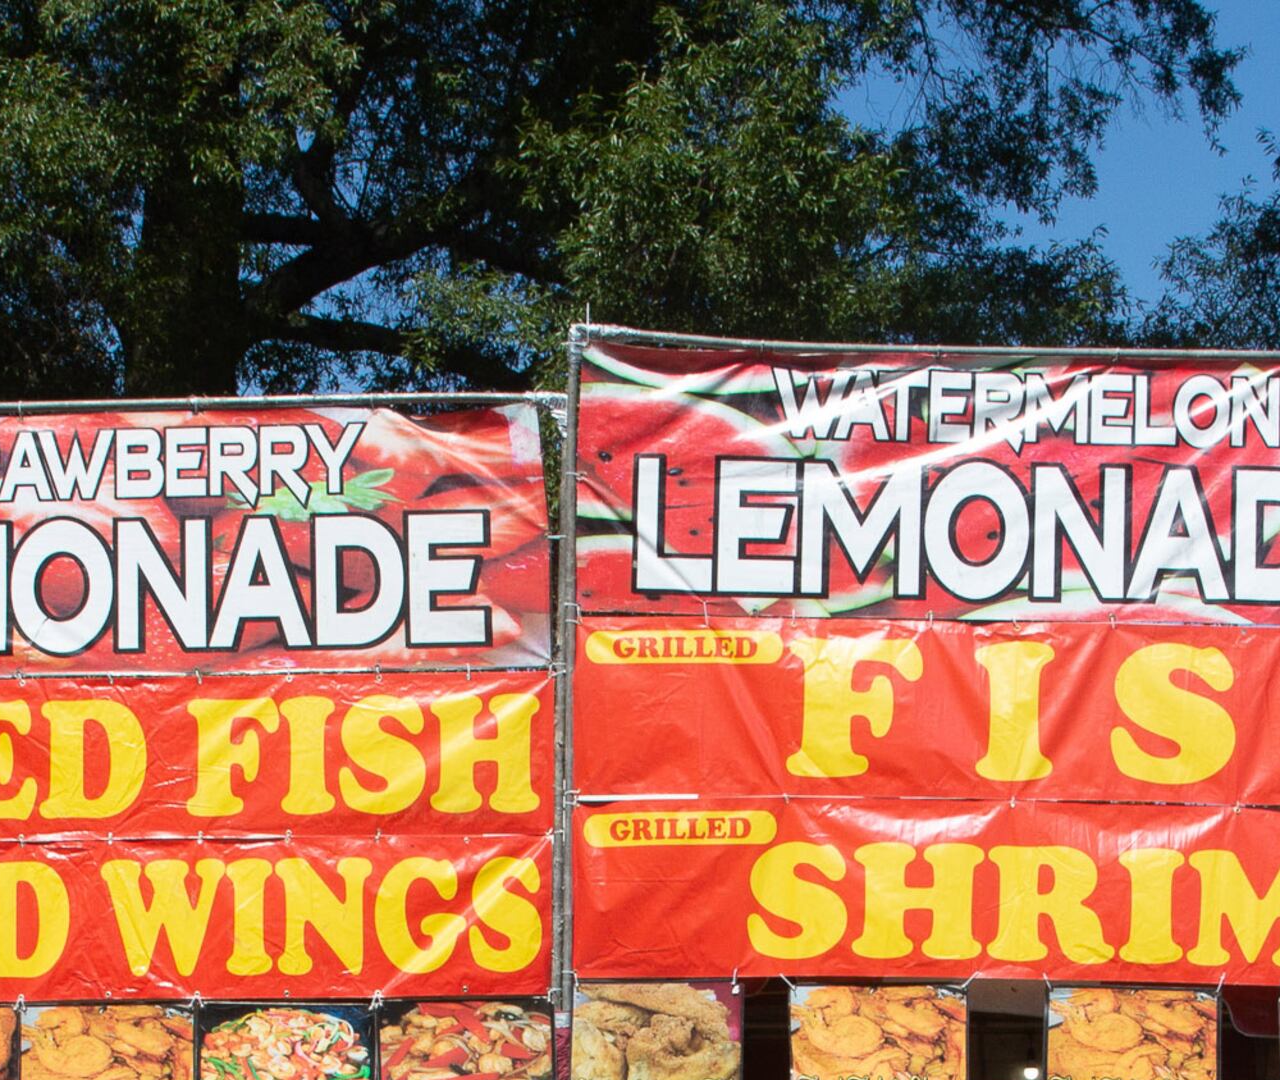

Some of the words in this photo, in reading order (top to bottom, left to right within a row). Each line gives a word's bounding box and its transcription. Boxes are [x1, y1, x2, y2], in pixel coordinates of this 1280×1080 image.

[612, 635, 759, 660] GRILLED
[187, 692, 541, 817] FISH
[609, 816, 752, 841] GRILLED
[100, 856, 543, 977] WINGS
